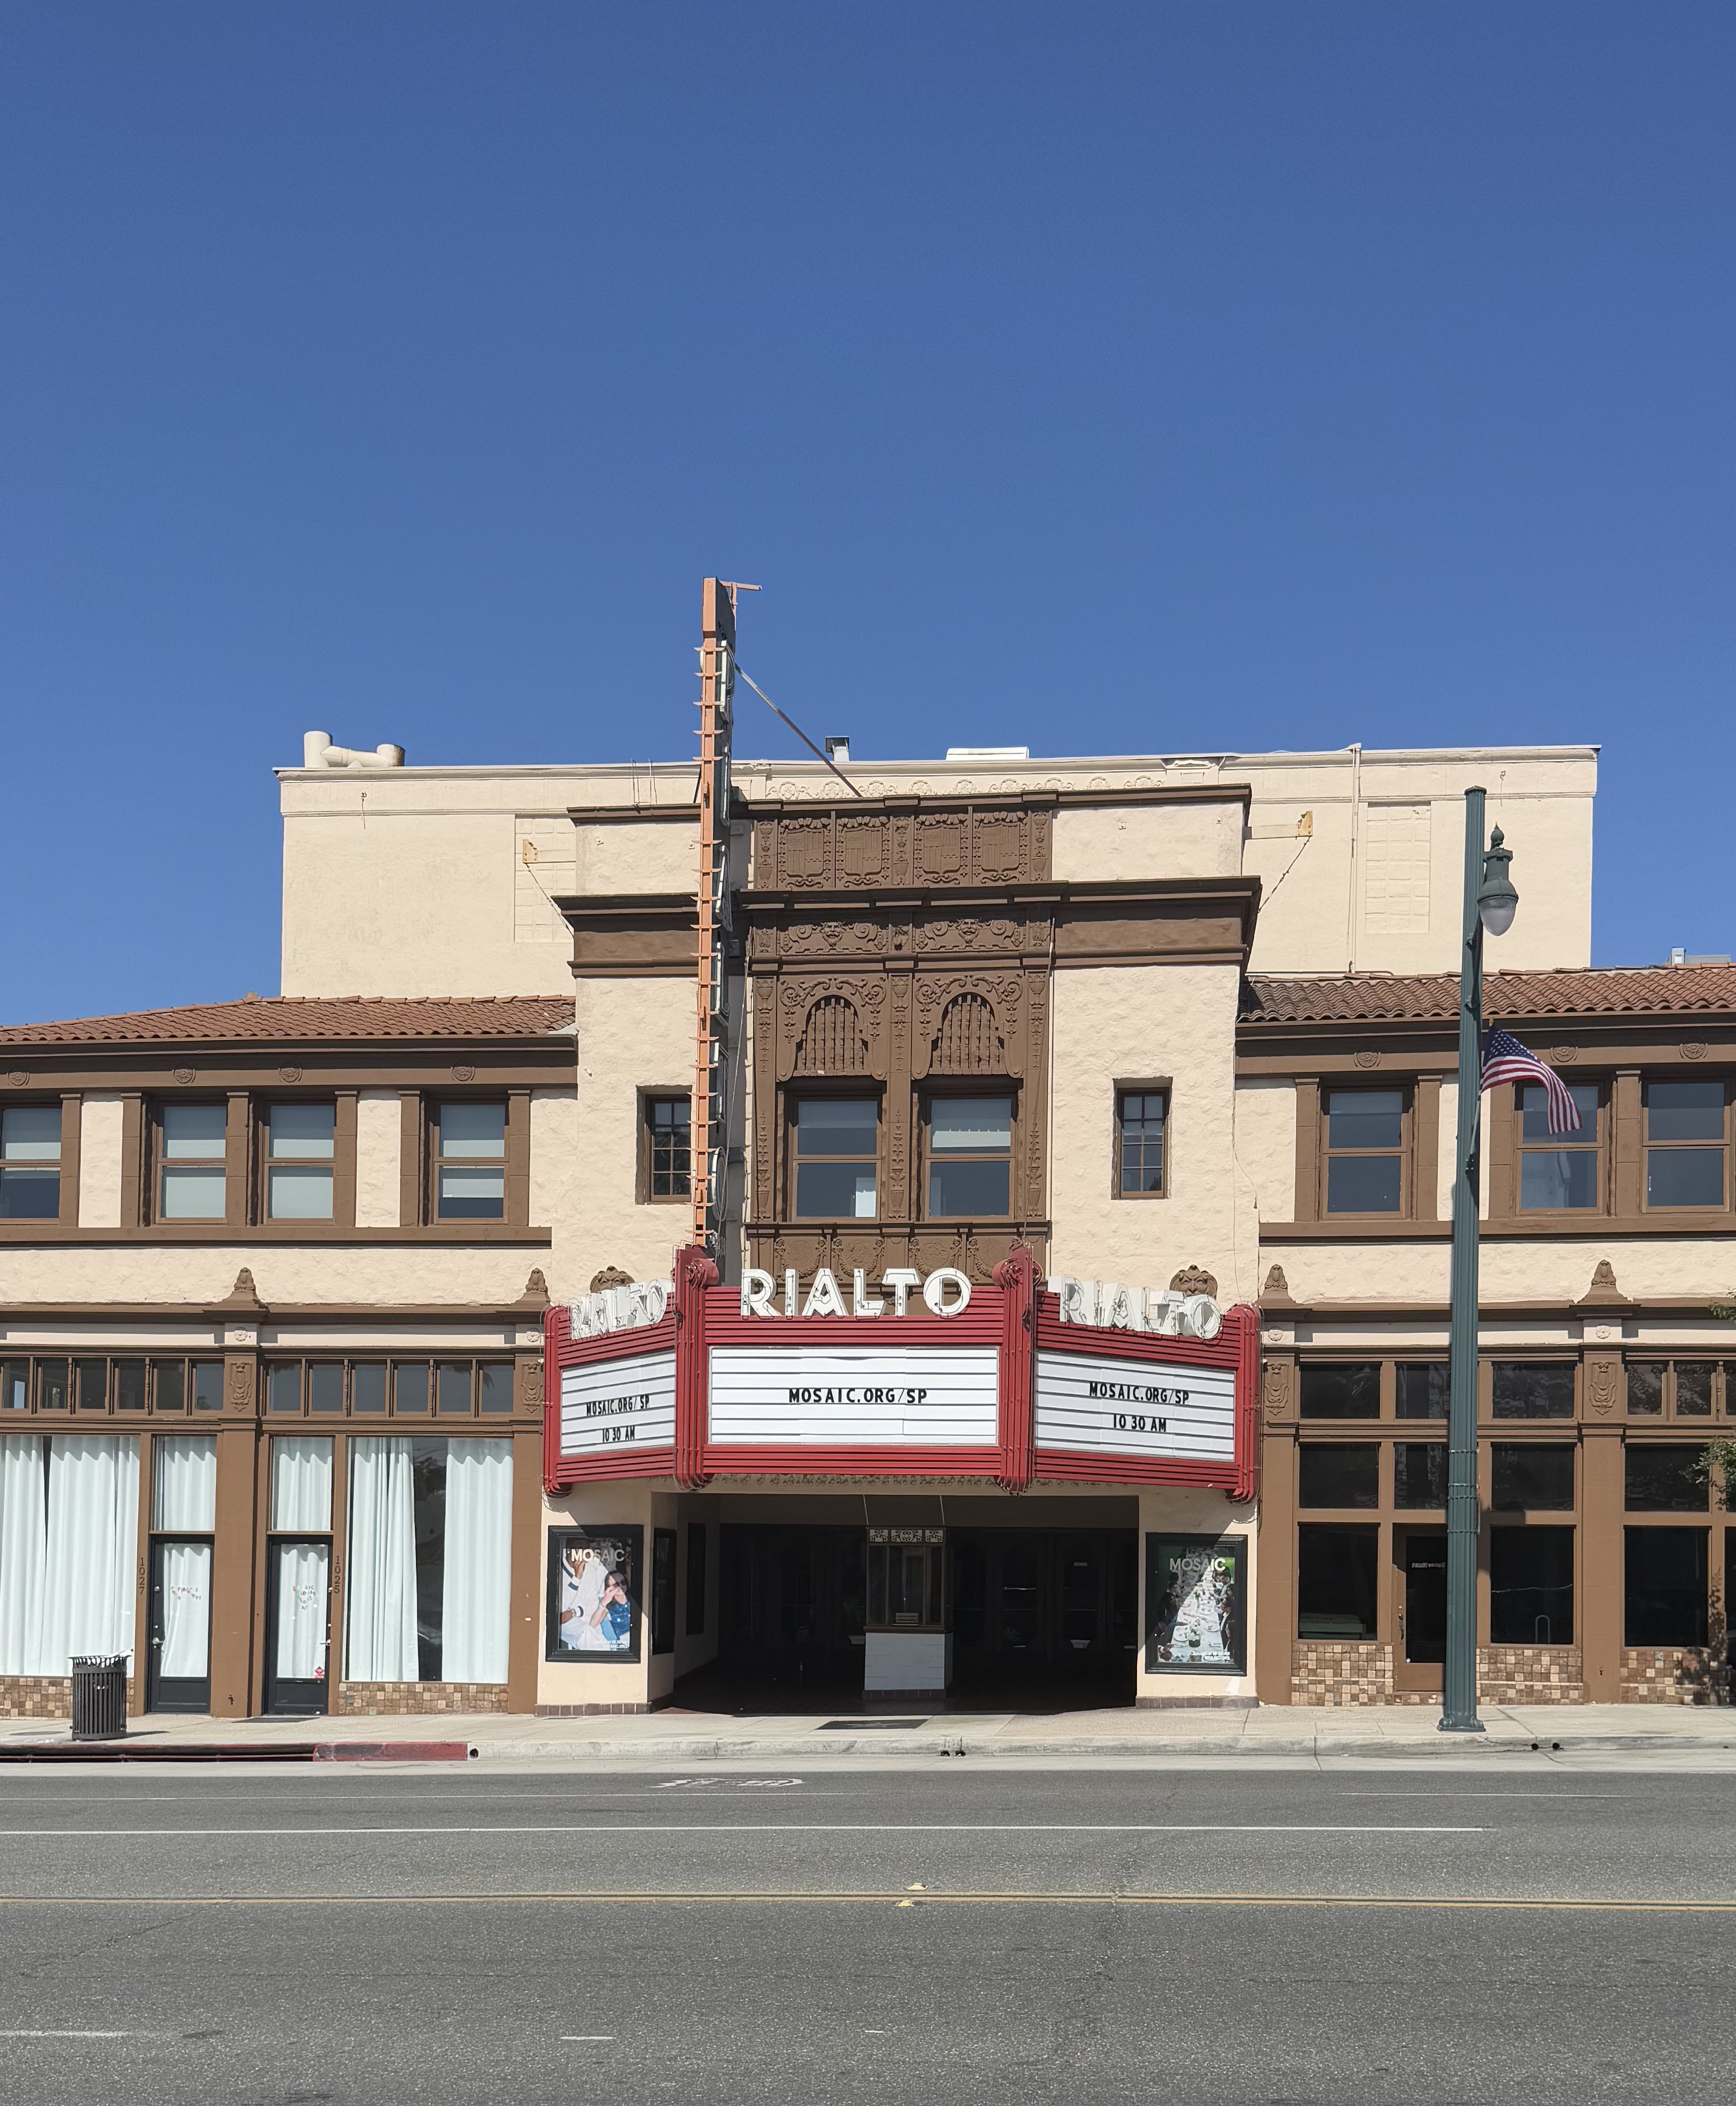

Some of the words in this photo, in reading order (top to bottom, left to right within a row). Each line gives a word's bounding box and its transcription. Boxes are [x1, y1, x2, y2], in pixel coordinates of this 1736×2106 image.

[741, 1268, 972, 1317] RIALTO
[569, 1280, 668, 1340] RIALTO
[1059, 1277, 1221, 1340] RIALTO
[789, 1388, 927, 1404] MOSAIC.ORG/SP
[1089, 1382, 1189, 1405] MOSAIC.ORG/SP
[1114, 1414, 1126, 1429] 10
[1131, 1417, 1146, 1431] 30
[1150, 1418, 1166, 1432] AM
[625, 1425, 635, 1440] AM
[571, 1548, 625, 1562] MOSAIC
[1170, 1558, 1226, 1572] MOSAIC
